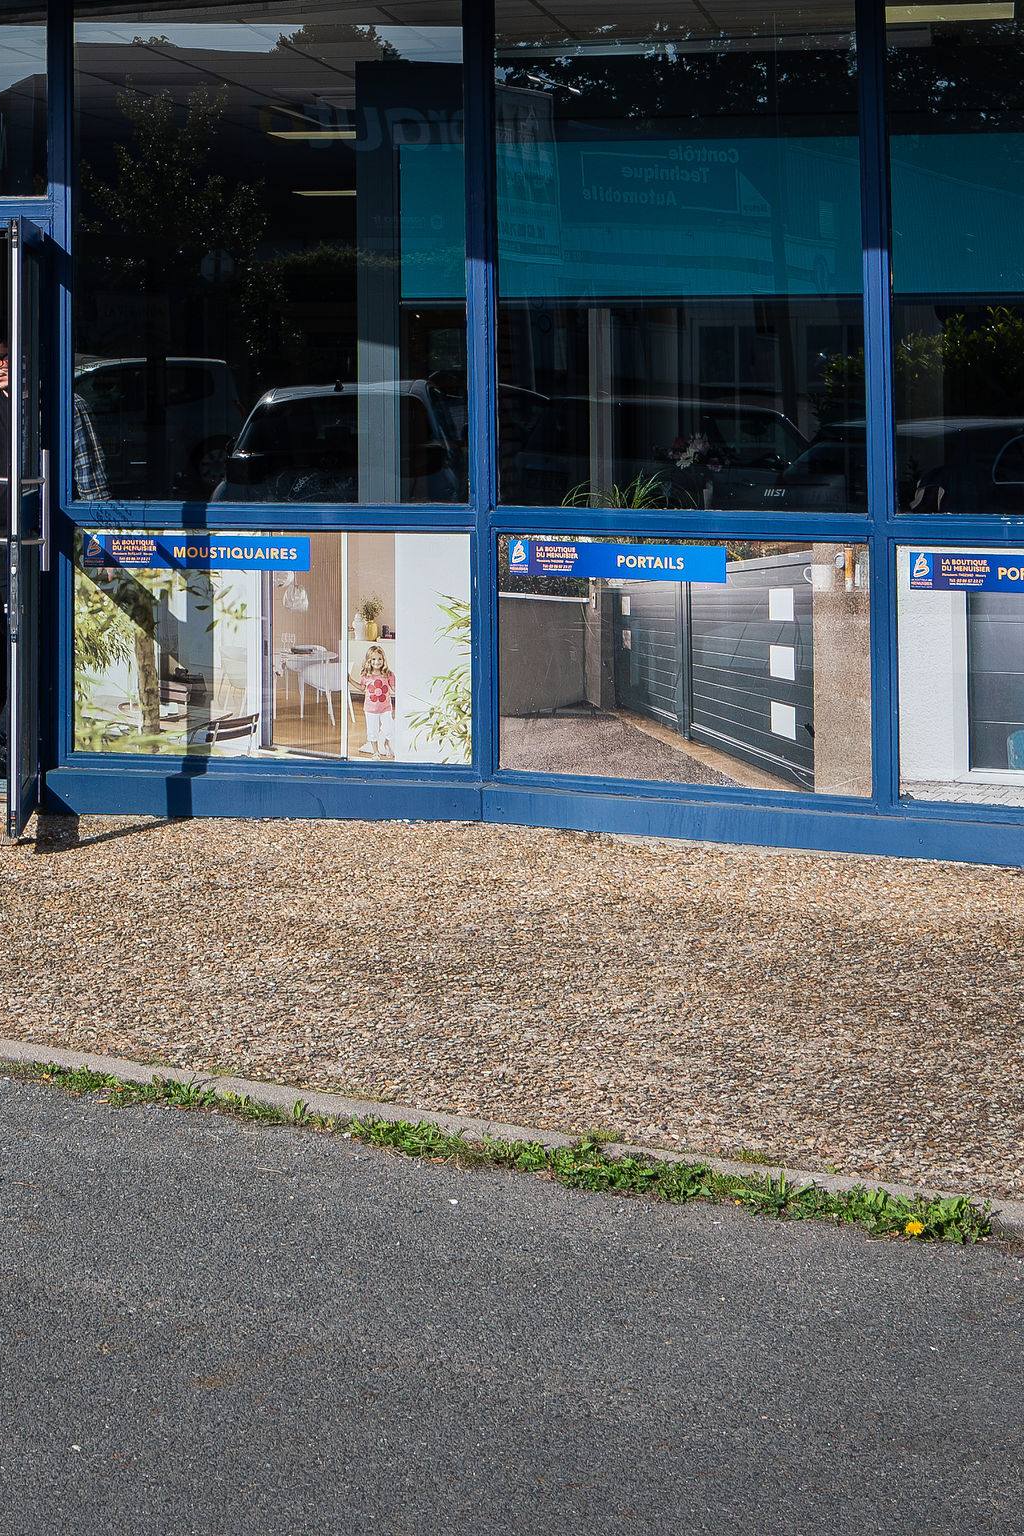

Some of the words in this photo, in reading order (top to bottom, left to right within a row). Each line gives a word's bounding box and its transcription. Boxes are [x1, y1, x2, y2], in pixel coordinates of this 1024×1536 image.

[173, 546, 298, 560] MOUSTIQUAIRES
[617, 555, 684, 570] PORTAILS
[953, 565, 991, 573] MENUISIER
